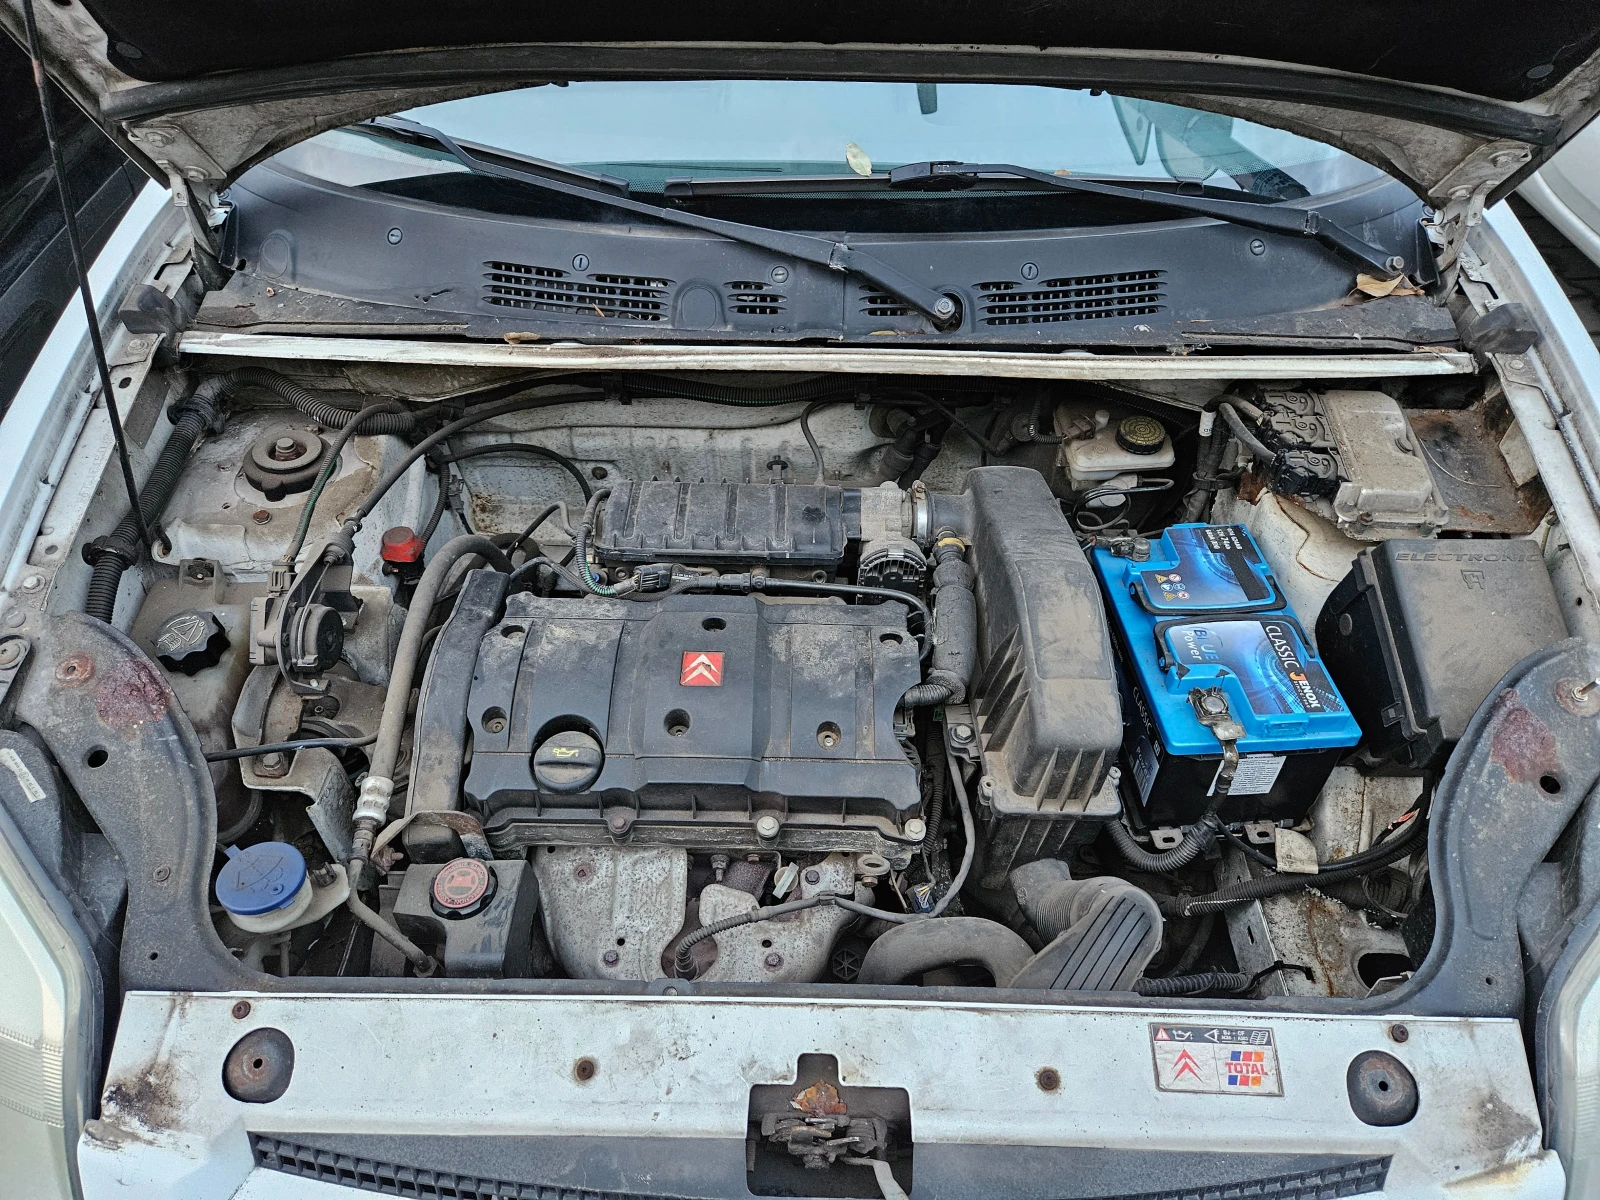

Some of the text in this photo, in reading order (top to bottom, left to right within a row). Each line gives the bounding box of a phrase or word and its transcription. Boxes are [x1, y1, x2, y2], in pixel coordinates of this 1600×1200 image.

[1395, 552, 1543, 562] ELECTRONIC
[1181, 630, 1203, 661] Power
[1193, 629, 1220, 661] BLUE
[1265, 625, 1300, 669] CLASSIC
[1289, 671, 1321, 708] JENOX
[1132, 686, 1153, 735] CLASSIC
[1225, 1062, 1268, 1075] TOTAL
